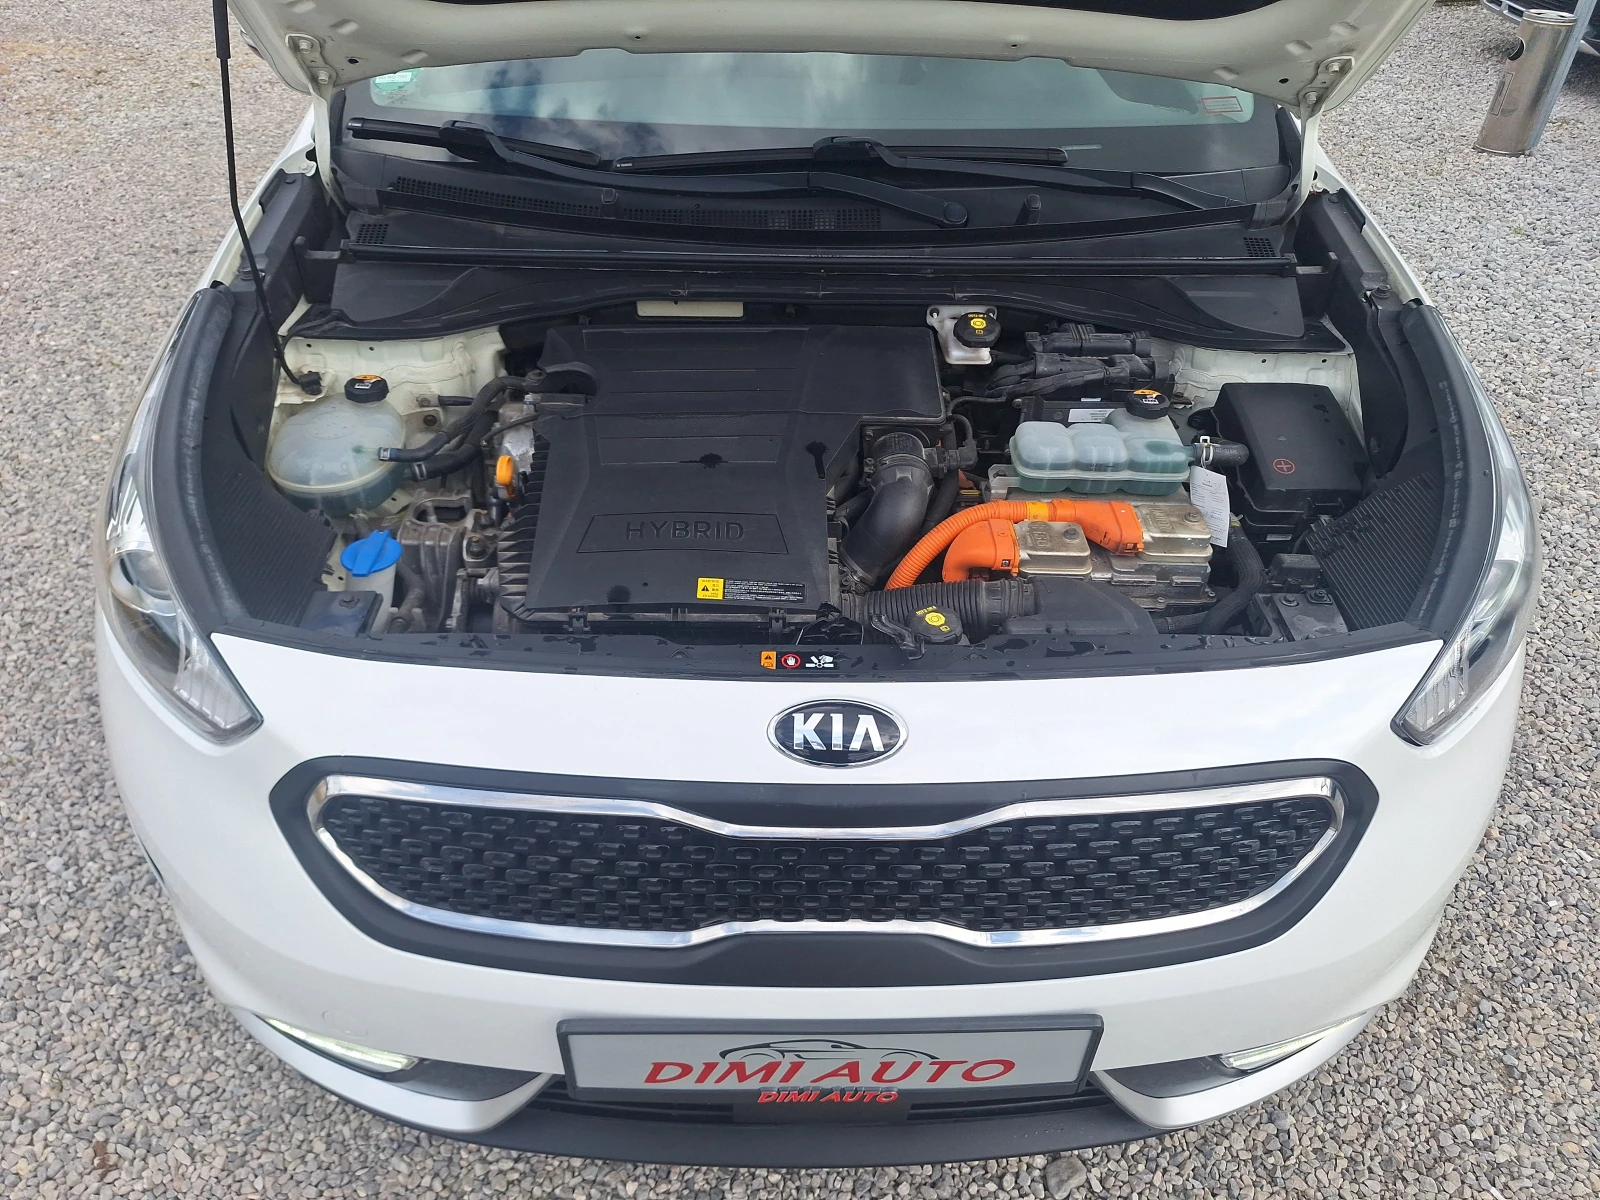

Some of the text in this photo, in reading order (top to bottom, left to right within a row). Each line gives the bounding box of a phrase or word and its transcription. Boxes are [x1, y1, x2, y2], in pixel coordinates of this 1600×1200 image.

[625, 520, 744, 540] HYBRID
[792, 712, 885, 751] KIA
[643, 1059, 1016, 1084] DIMI AUTO
[757, 1089, 899, 1103] DIMI AUTO
